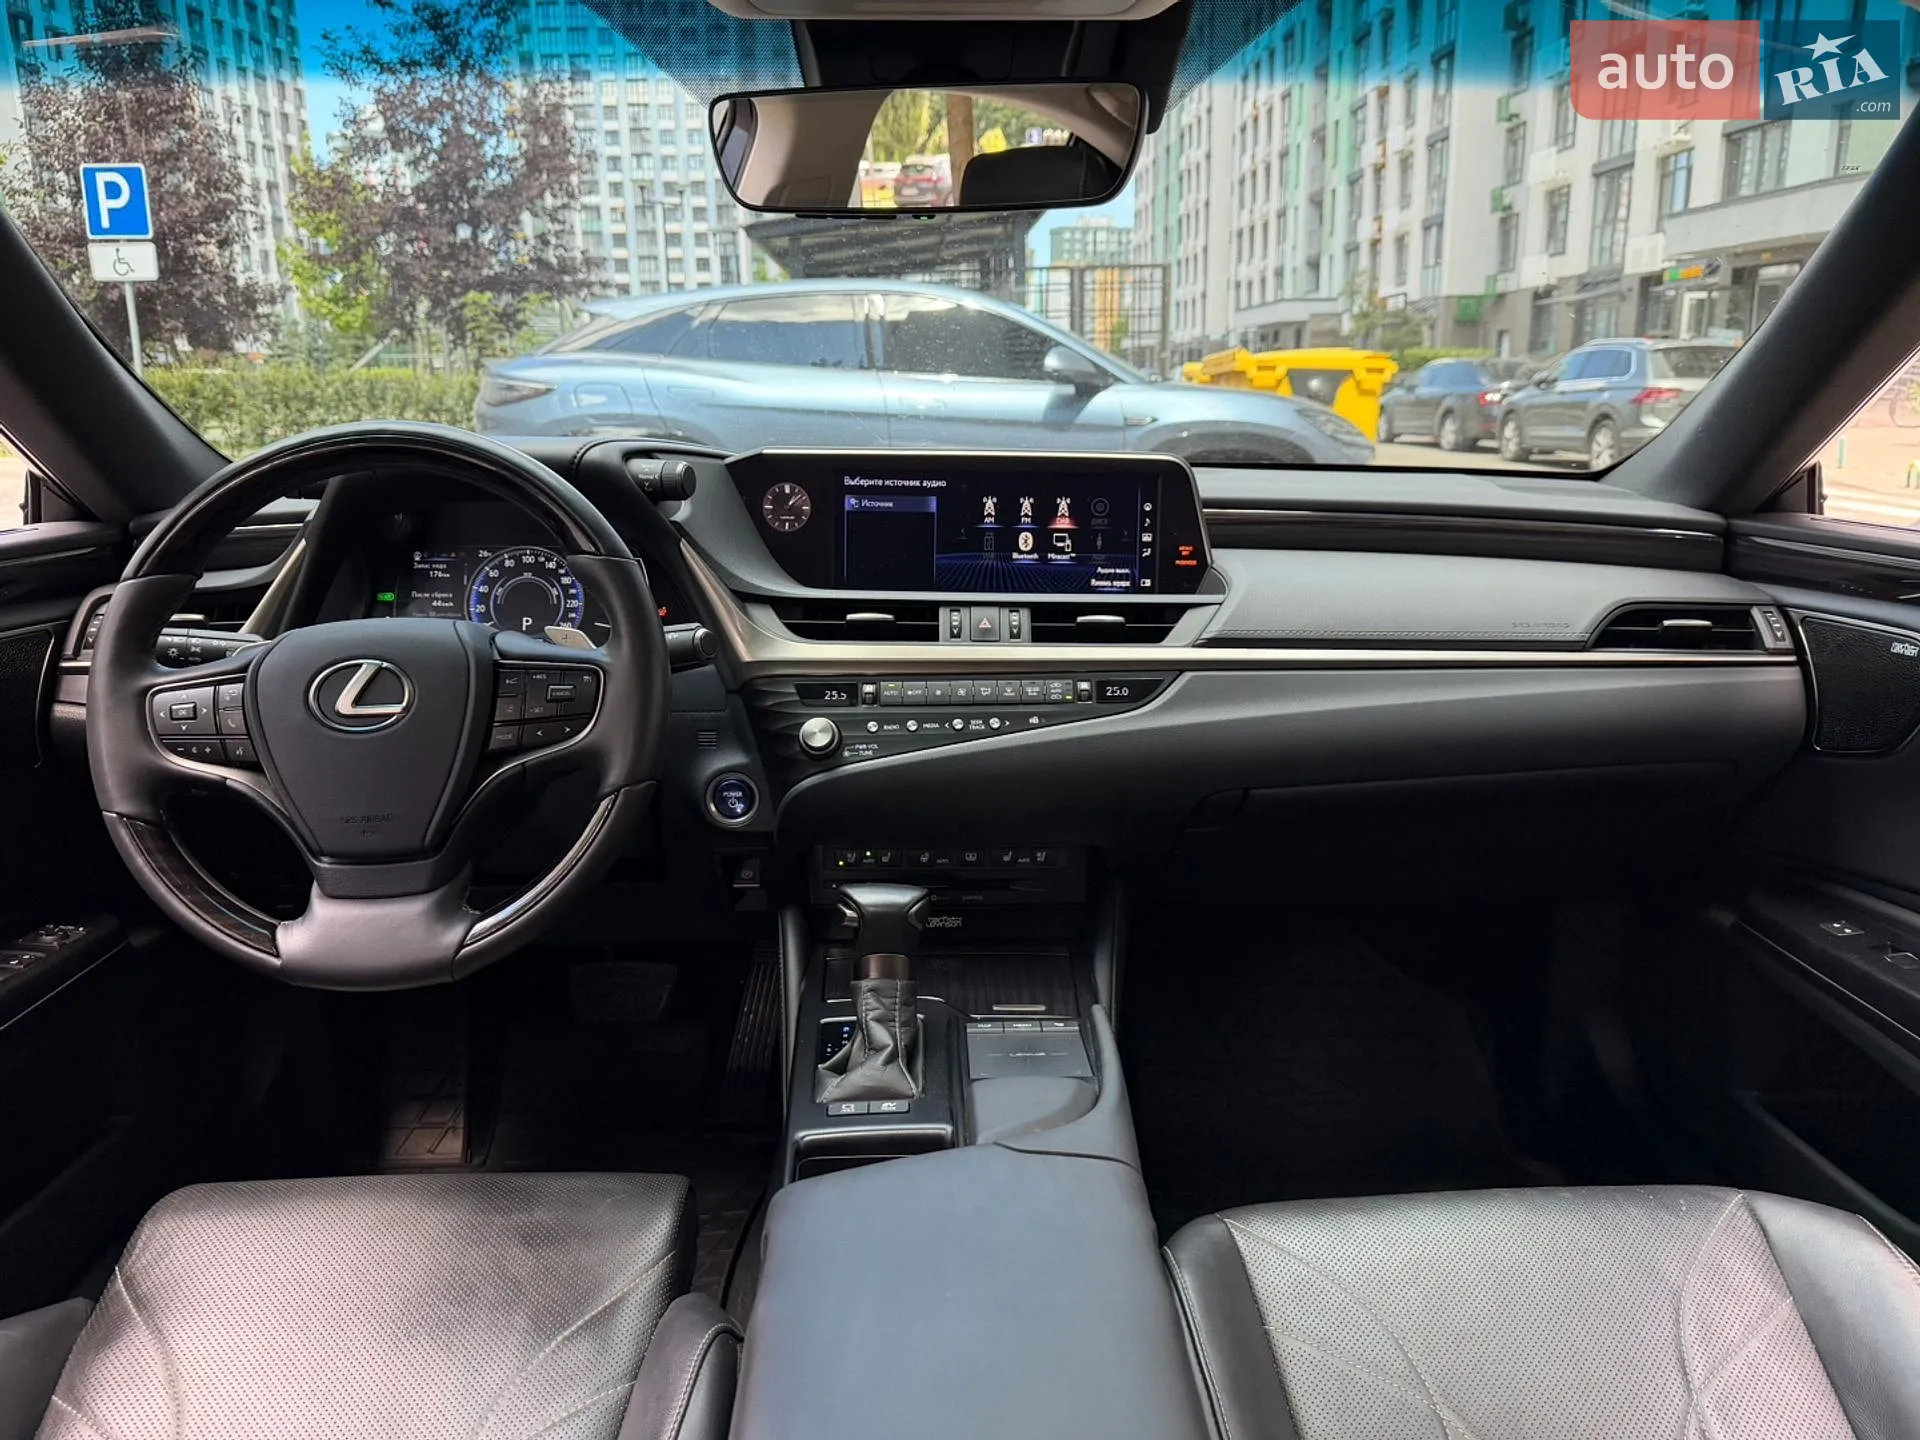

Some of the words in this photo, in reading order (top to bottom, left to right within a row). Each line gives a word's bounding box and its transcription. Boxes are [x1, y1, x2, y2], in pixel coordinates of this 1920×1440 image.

[95, 171, 130, 229] P
[843, 475, 883, 487] Выберите
[884, 479, 921, 487] источник
[922, 479, 947, 489] аудио
[504, 559, 516, 567] 80
[521, 555, 536, 564] 100
[545, 561, 557, 569] 140
[488, 568, 500, 578] 60
[560, 576, 572, 584] 180
[478, 585, 489, 593] 40
[566, 599, 579, 608] 220
[475, 604, 486, 613] 20
[522, 617, 533, 631] P
[823, 690, 848, 701] 25.5
[1105, 686, 1130, 697] 25.0
